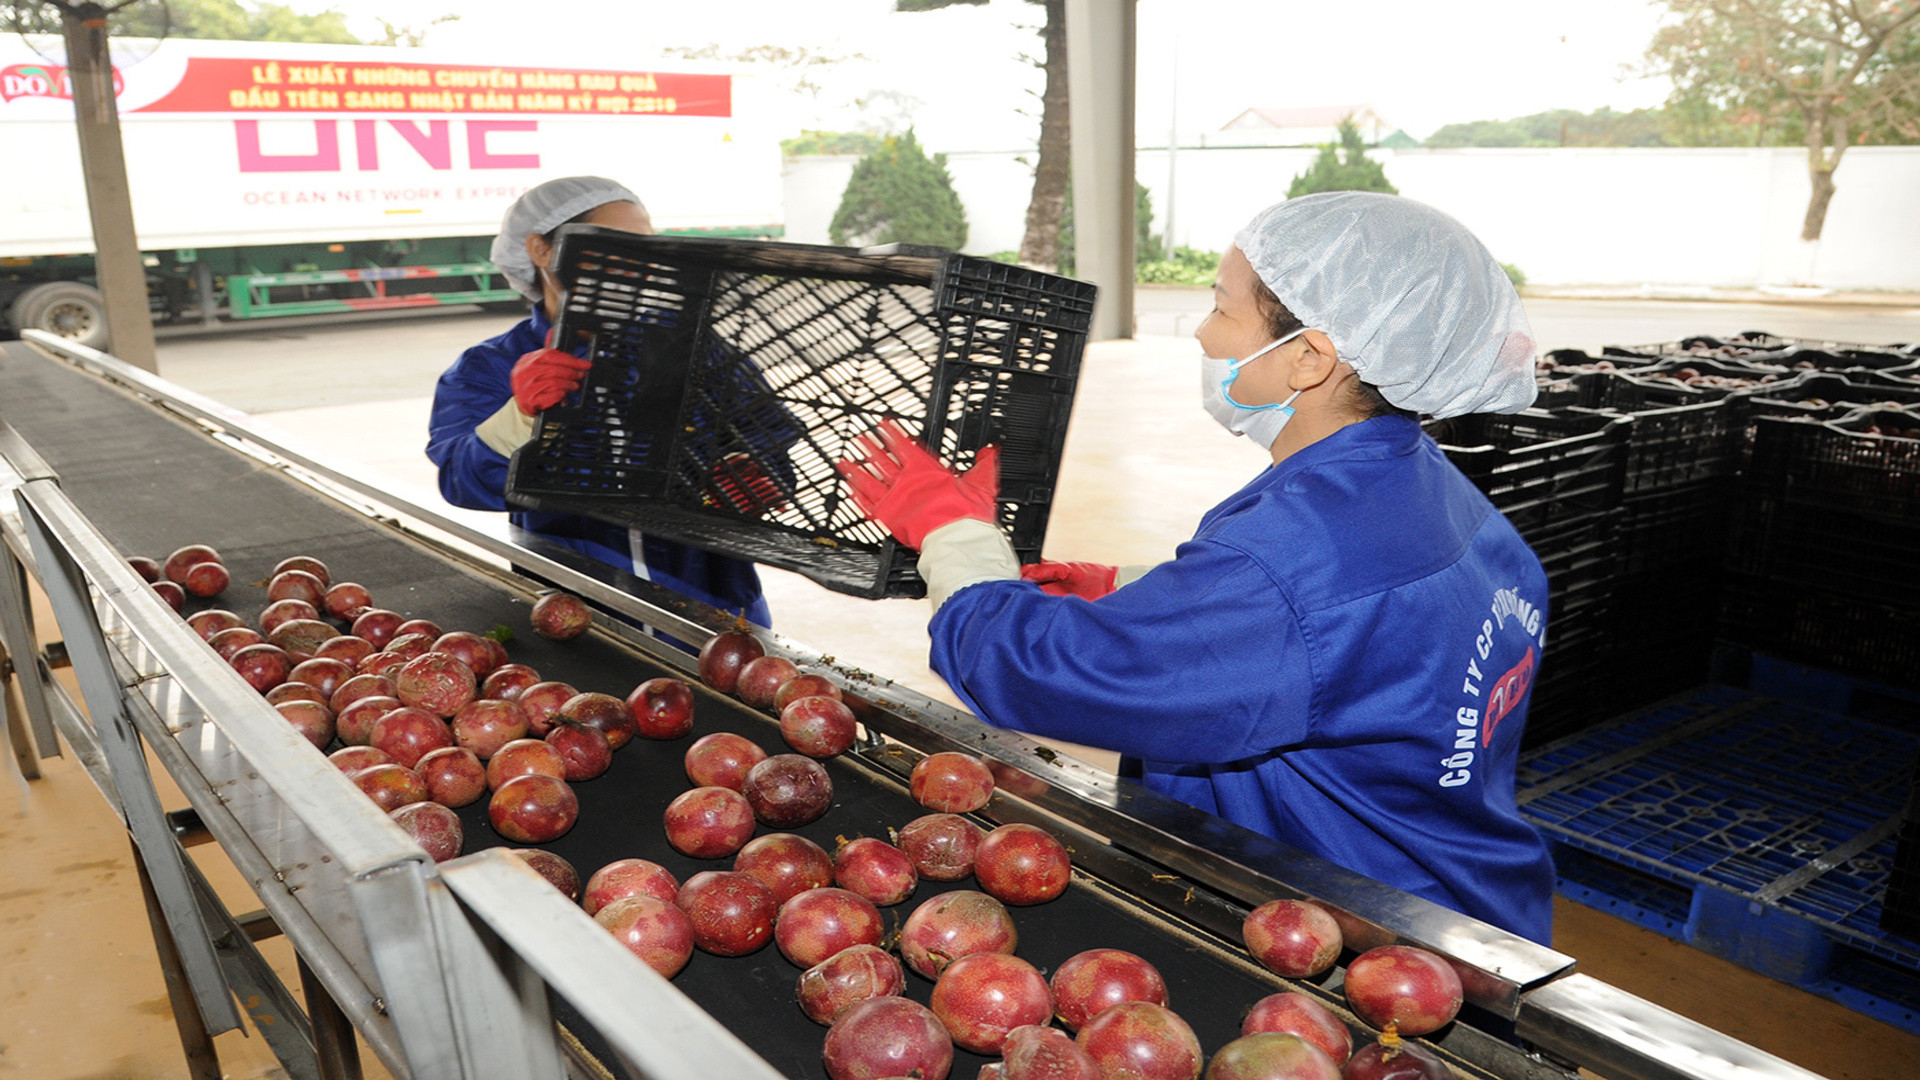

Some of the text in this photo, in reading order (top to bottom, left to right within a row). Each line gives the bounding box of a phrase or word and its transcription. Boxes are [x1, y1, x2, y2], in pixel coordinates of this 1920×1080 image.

[285, 88, 339, 109] TIÊN
[344, 91, 406, 109] SANG
[243, 190, 327, 205] OCEAN
[337, 186, 443, 203] NETWORK
[1438, 619, 1494, 788] CÔNG TY CP
